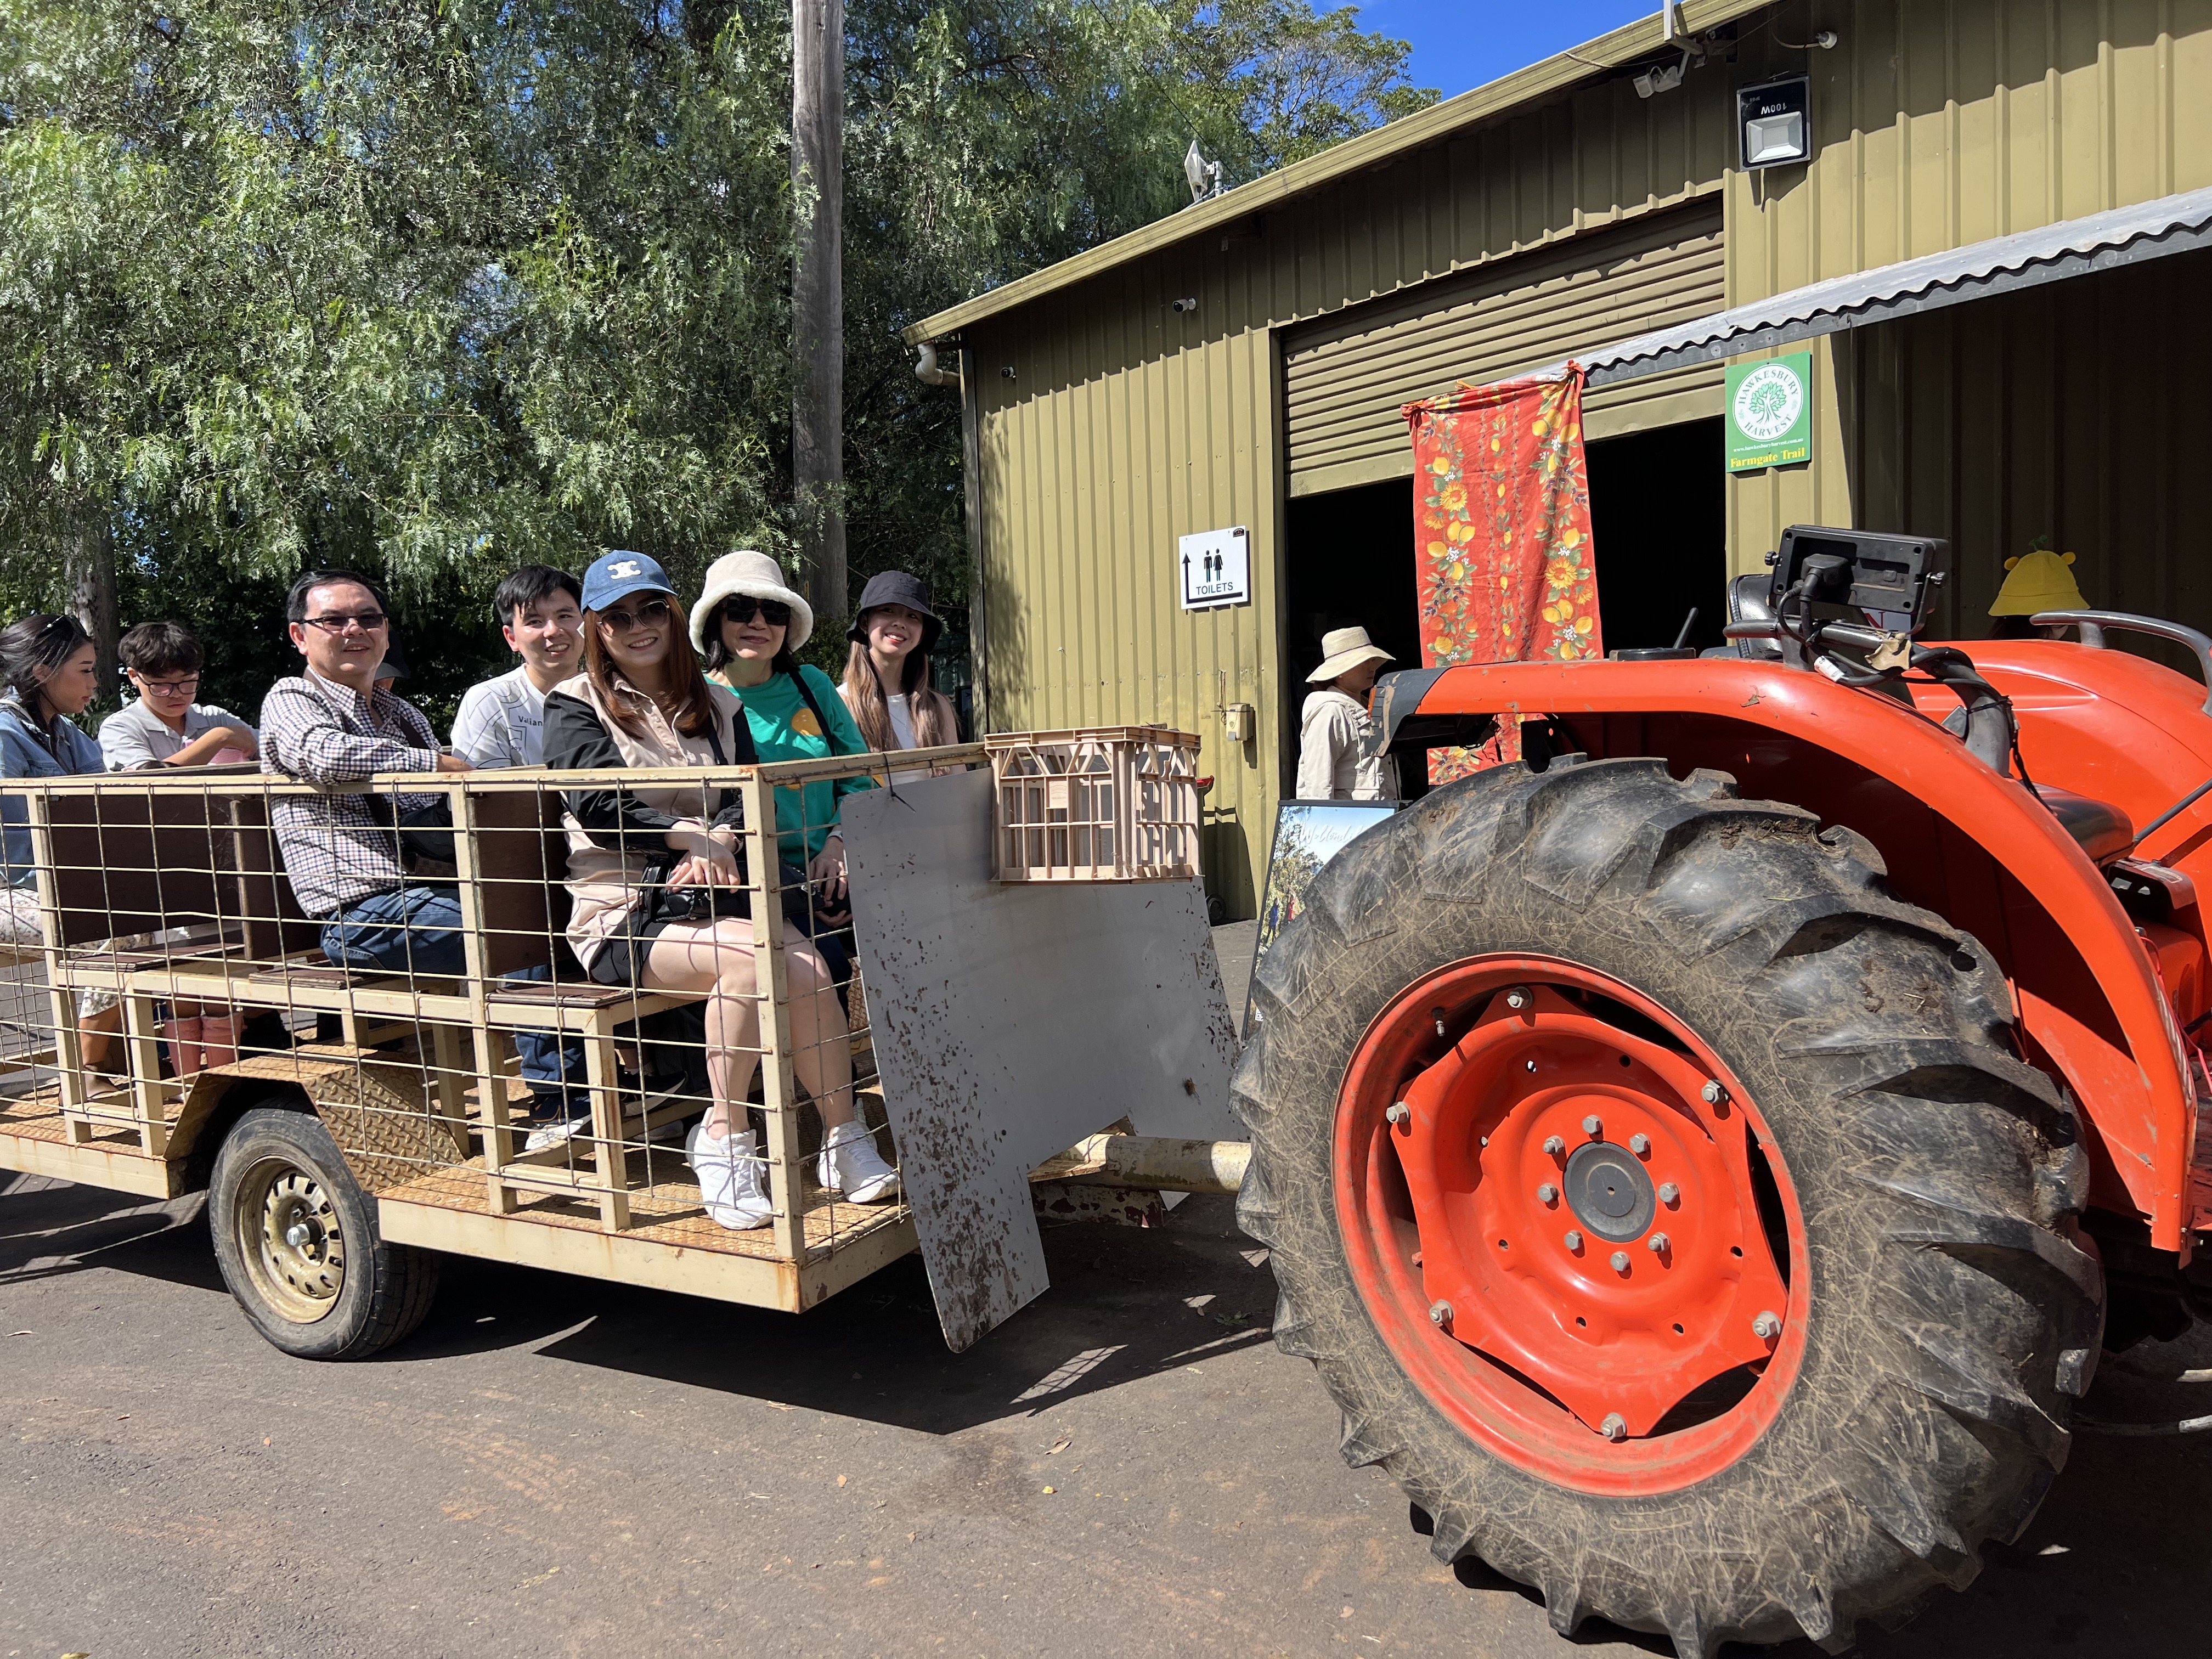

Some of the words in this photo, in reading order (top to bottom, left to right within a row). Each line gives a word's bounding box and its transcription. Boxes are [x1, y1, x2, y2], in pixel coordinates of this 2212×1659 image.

[1761, 103, 1787, 115] 100W
[1739, 370, 1798, 404] HAWKESBURY
[1745, 414, 1792, 436] HARVEST
[1733, 438, 1803, 452] www.hawkesburyharvest.com.au
[1730, 453, 1778, 467] Farmgate
[1782, 447, 1805, 460] Trail
[1196, 582, 1233, 595] TOILETS
